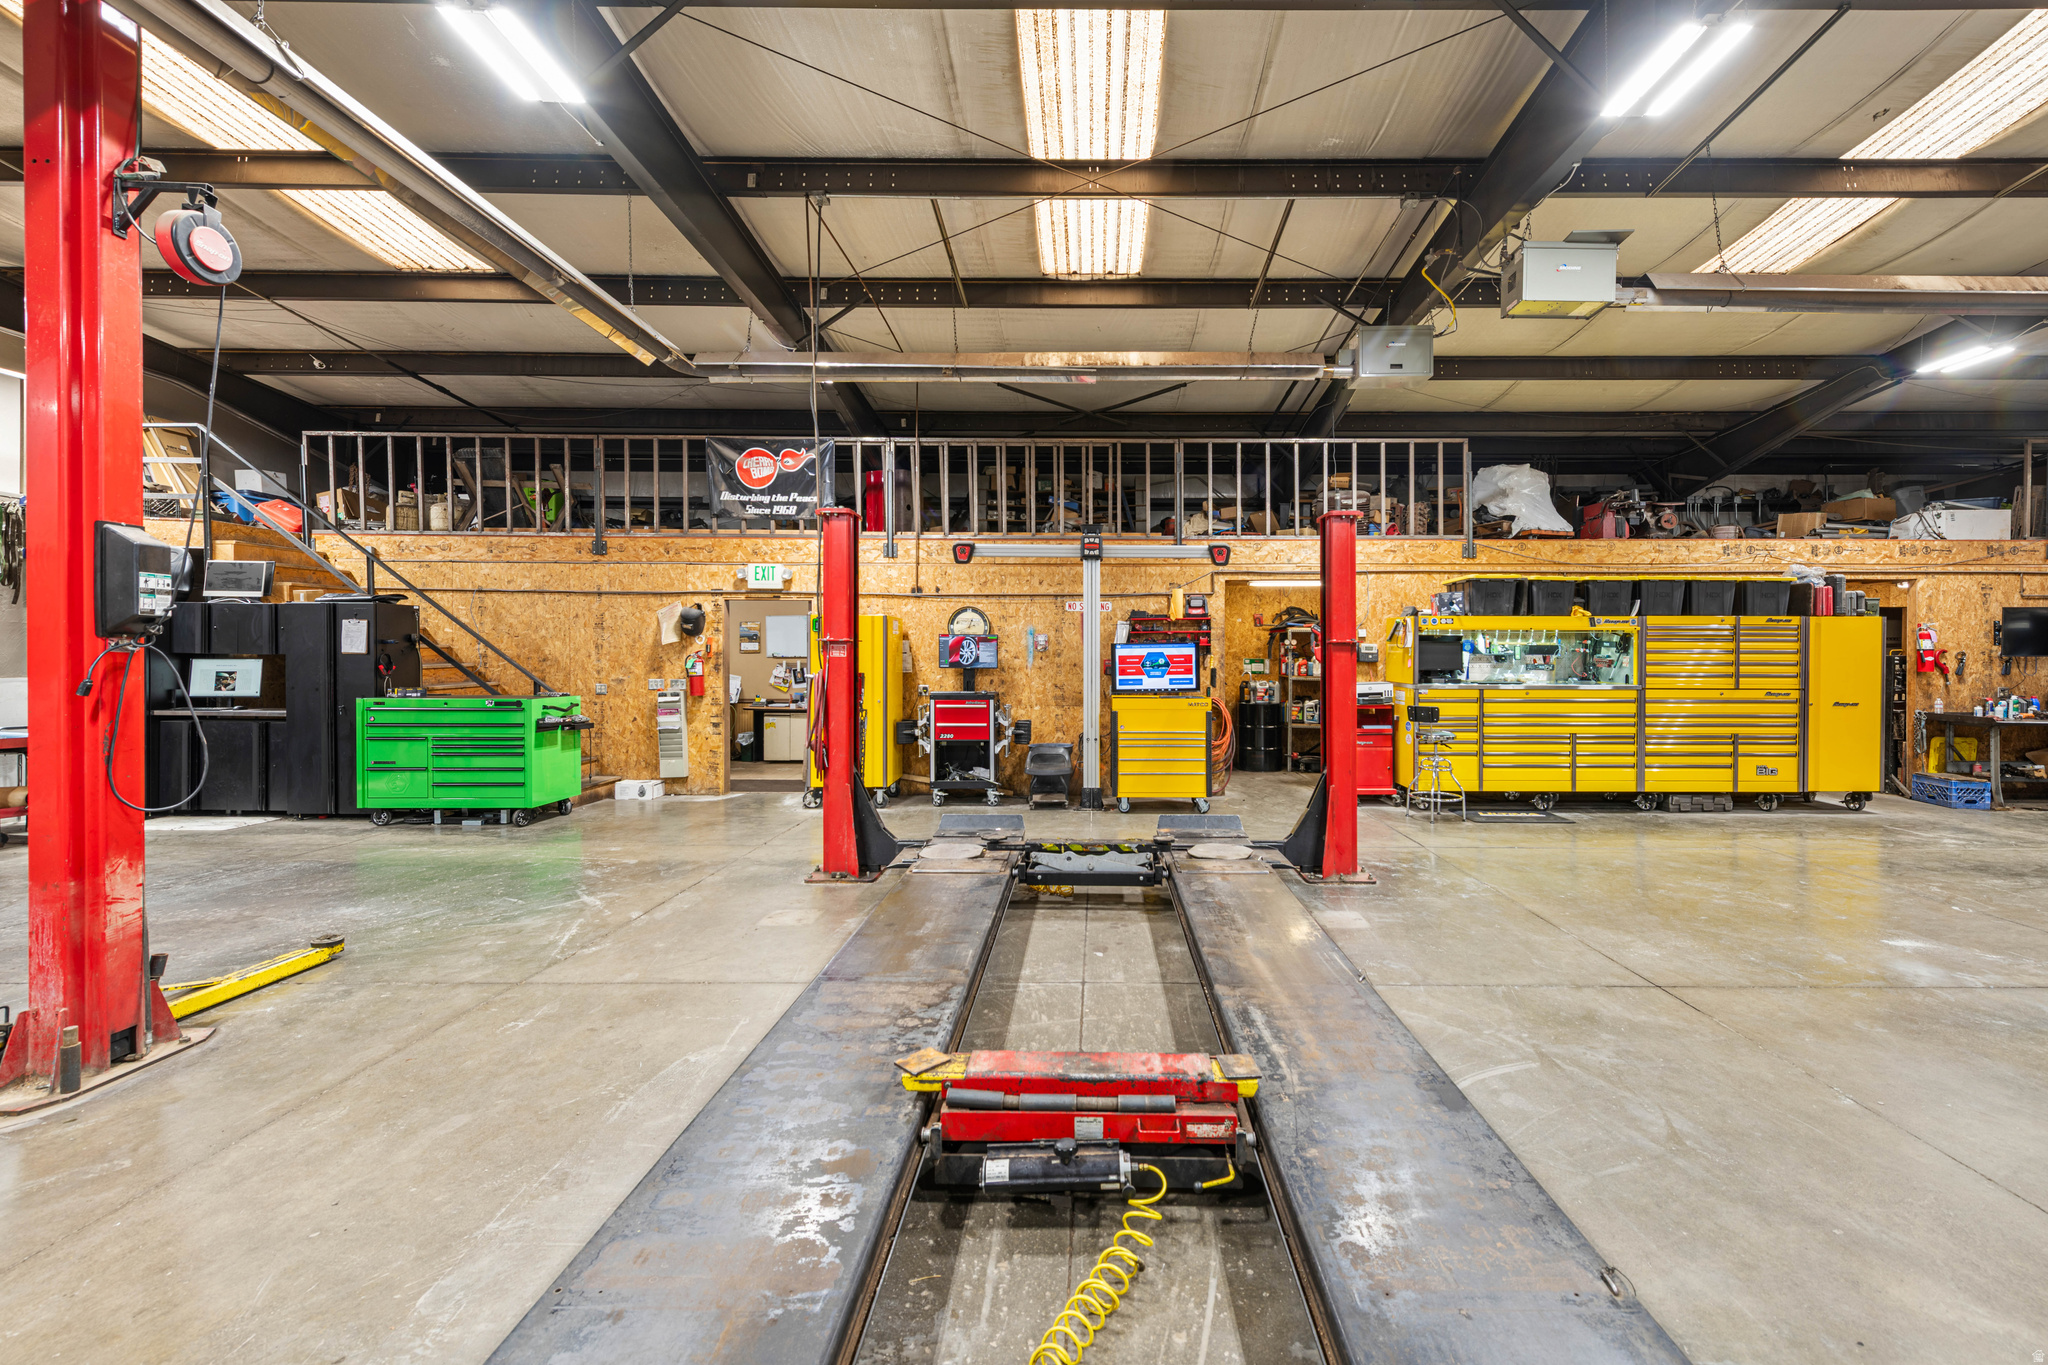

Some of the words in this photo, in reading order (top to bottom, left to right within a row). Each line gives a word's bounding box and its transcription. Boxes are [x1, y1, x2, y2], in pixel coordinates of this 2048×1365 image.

[743, 456, 773, 469] CHERRY
[750, 466, 774, 479] BOMB
[720, 491, 771, 503] Disturbing
[771, 493, 788, 502] the
[745, 505, 770, 514] Since
[772, 505, 797, 514] 1968
[754, 565, 776, 581] EXIT
[1068, 602, 1077, 611] NO
